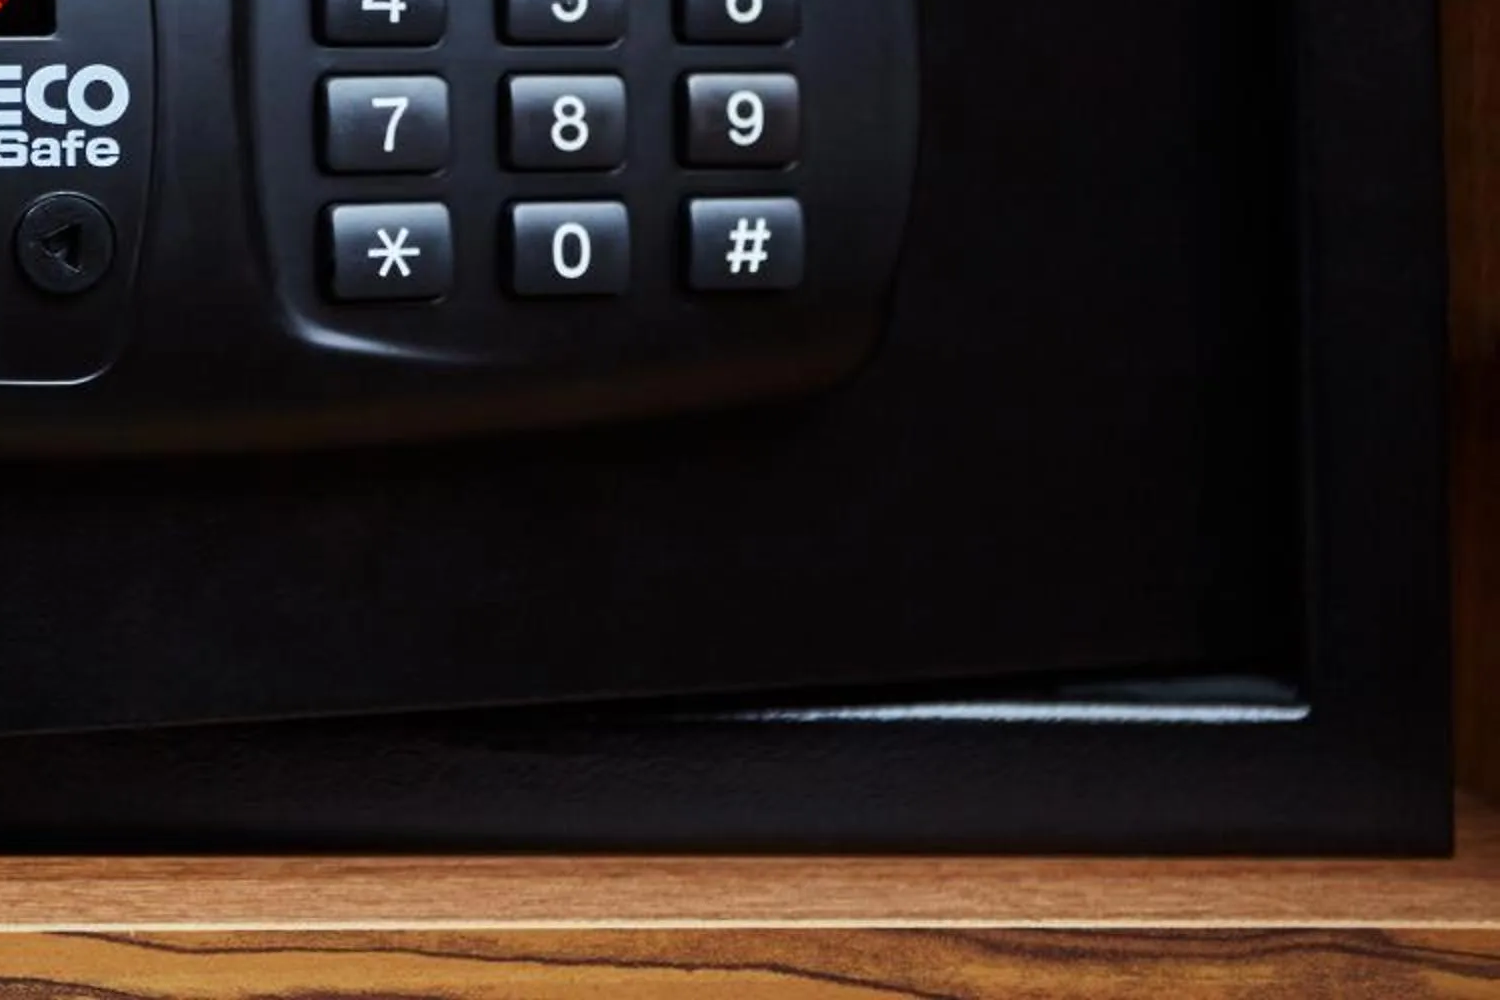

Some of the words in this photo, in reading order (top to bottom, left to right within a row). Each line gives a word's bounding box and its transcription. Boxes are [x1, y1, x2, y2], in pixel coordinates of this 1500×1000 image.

[371, 96, 409, 152] 7
[551, 95, 588, 151] 8
[727, 90, 763, 145] 9
[553, 222, 591, 279] 0
[726, 218, 771, 273] #
